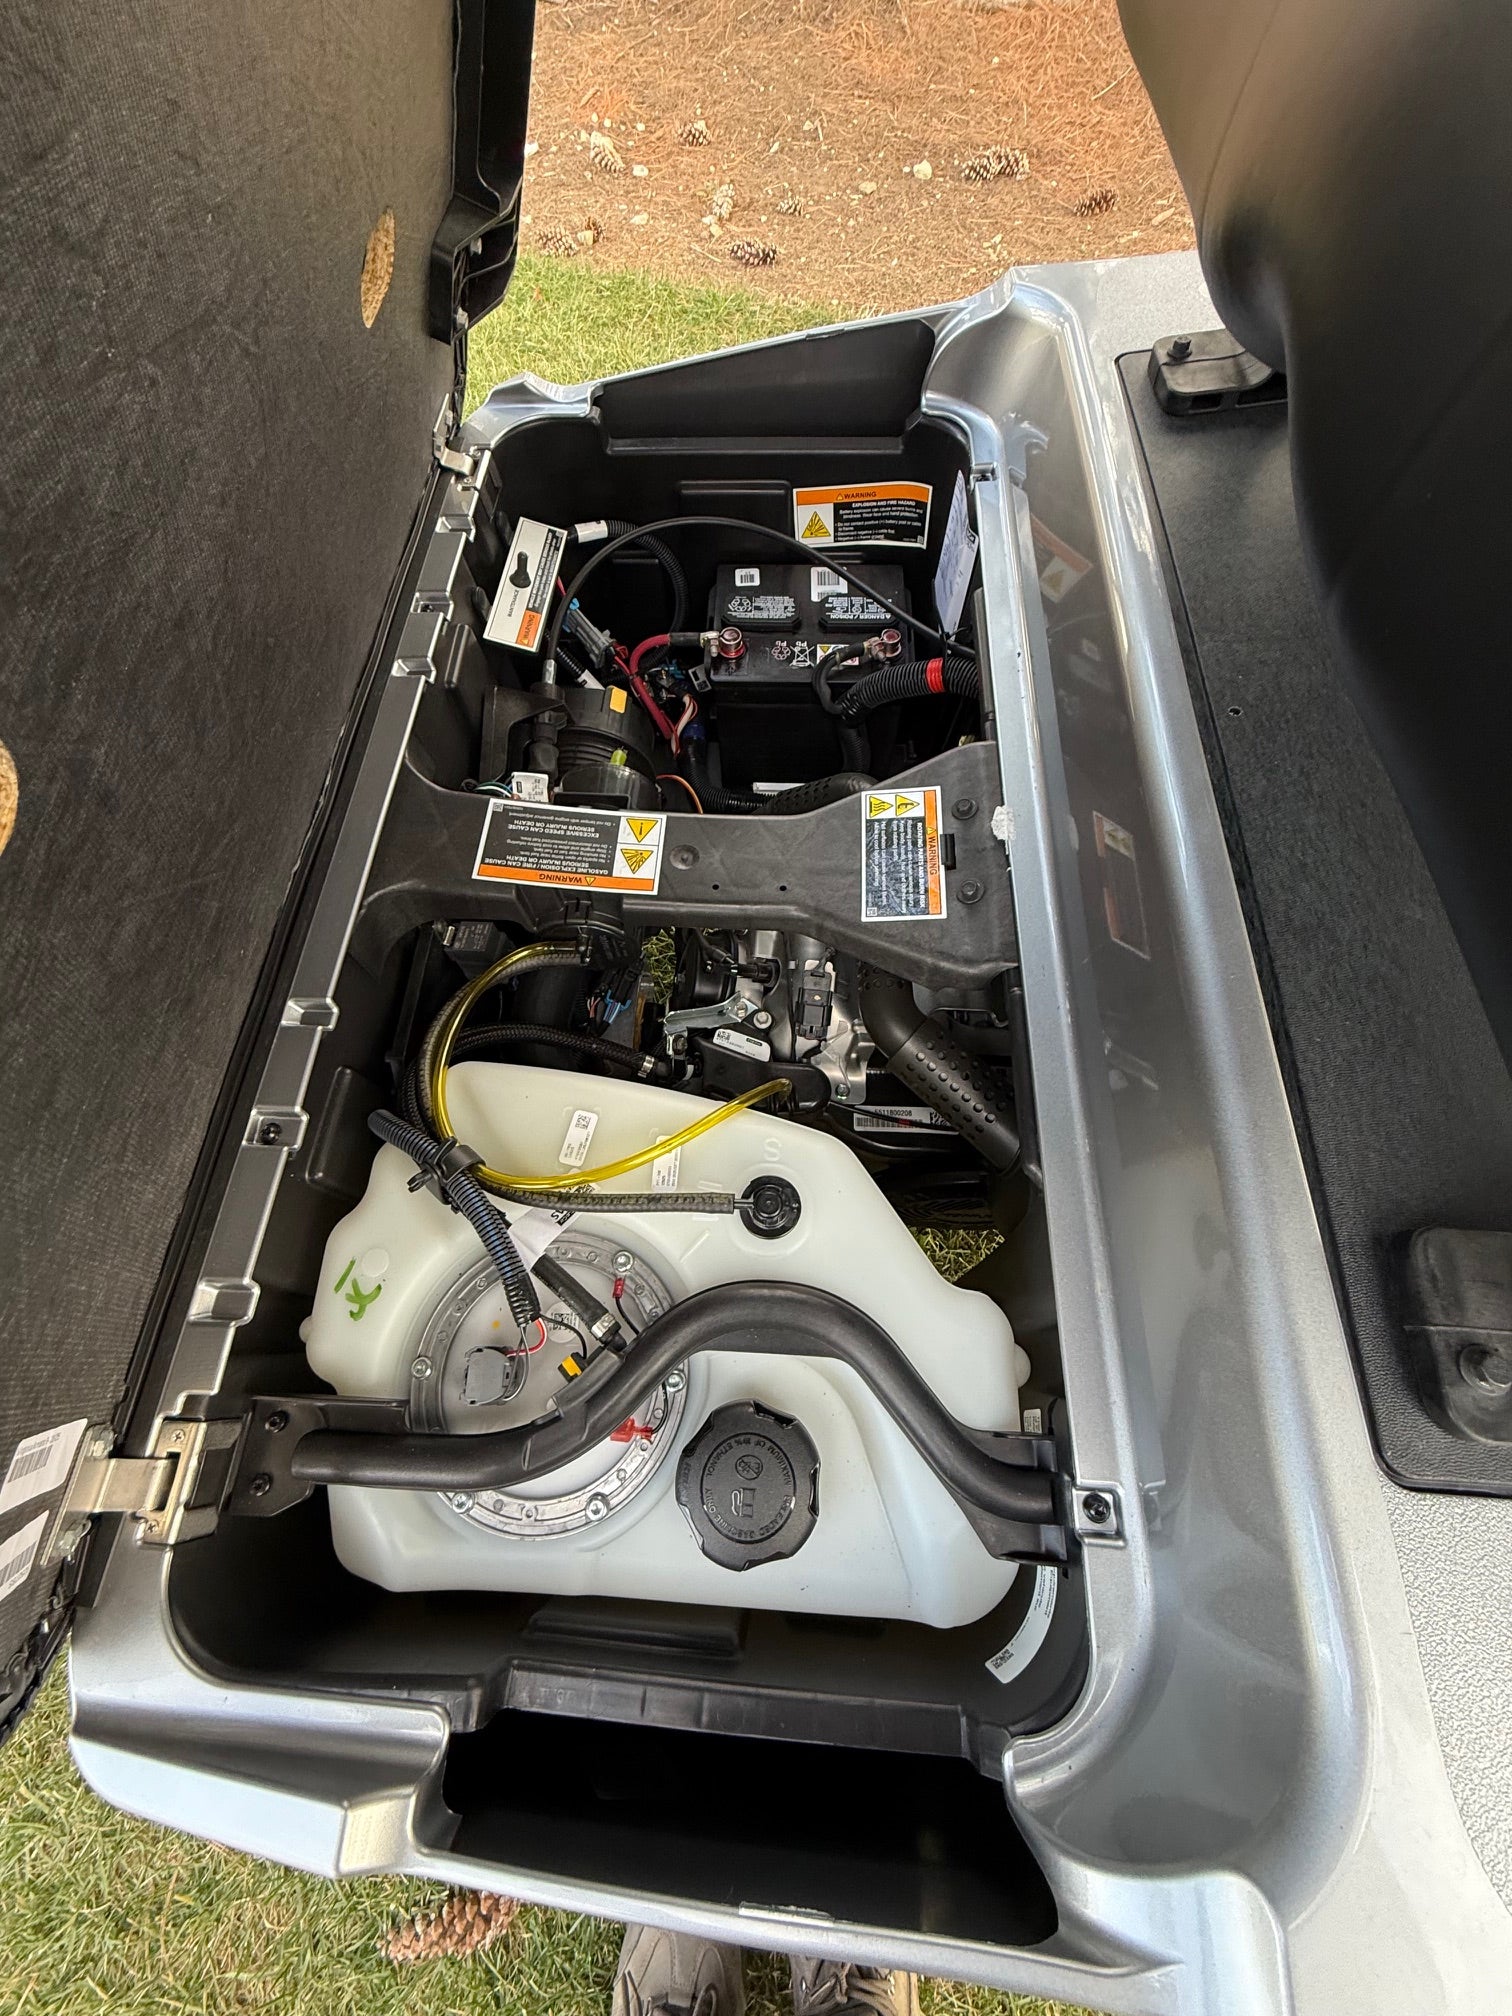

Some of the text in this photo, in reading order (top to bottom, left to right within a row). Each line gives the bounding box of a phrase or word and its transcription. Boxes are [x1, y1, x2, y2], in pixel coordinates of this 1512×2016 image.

[522, 613, 535, 640] WARNING
[545, 822, 568, 830] INJURY
[565, 830, 599, 838] EXCESSIVE
[928, 836, 938, 875] WARNING
[484, 857, 507, 865] CAUSE
[561, 860, 589, 868] SERIOUS
[540, 864, 576, 872] EXPLOSION
[576, 867, 609, 875] GASOLINE
[538, 873, 583, 884] WARNING
[704, 1440, 734, 1479] ETHANOL
[766, 1445, 792, 1487] MAXIMUM
[704, 1486, 717, 1514] ONLY
